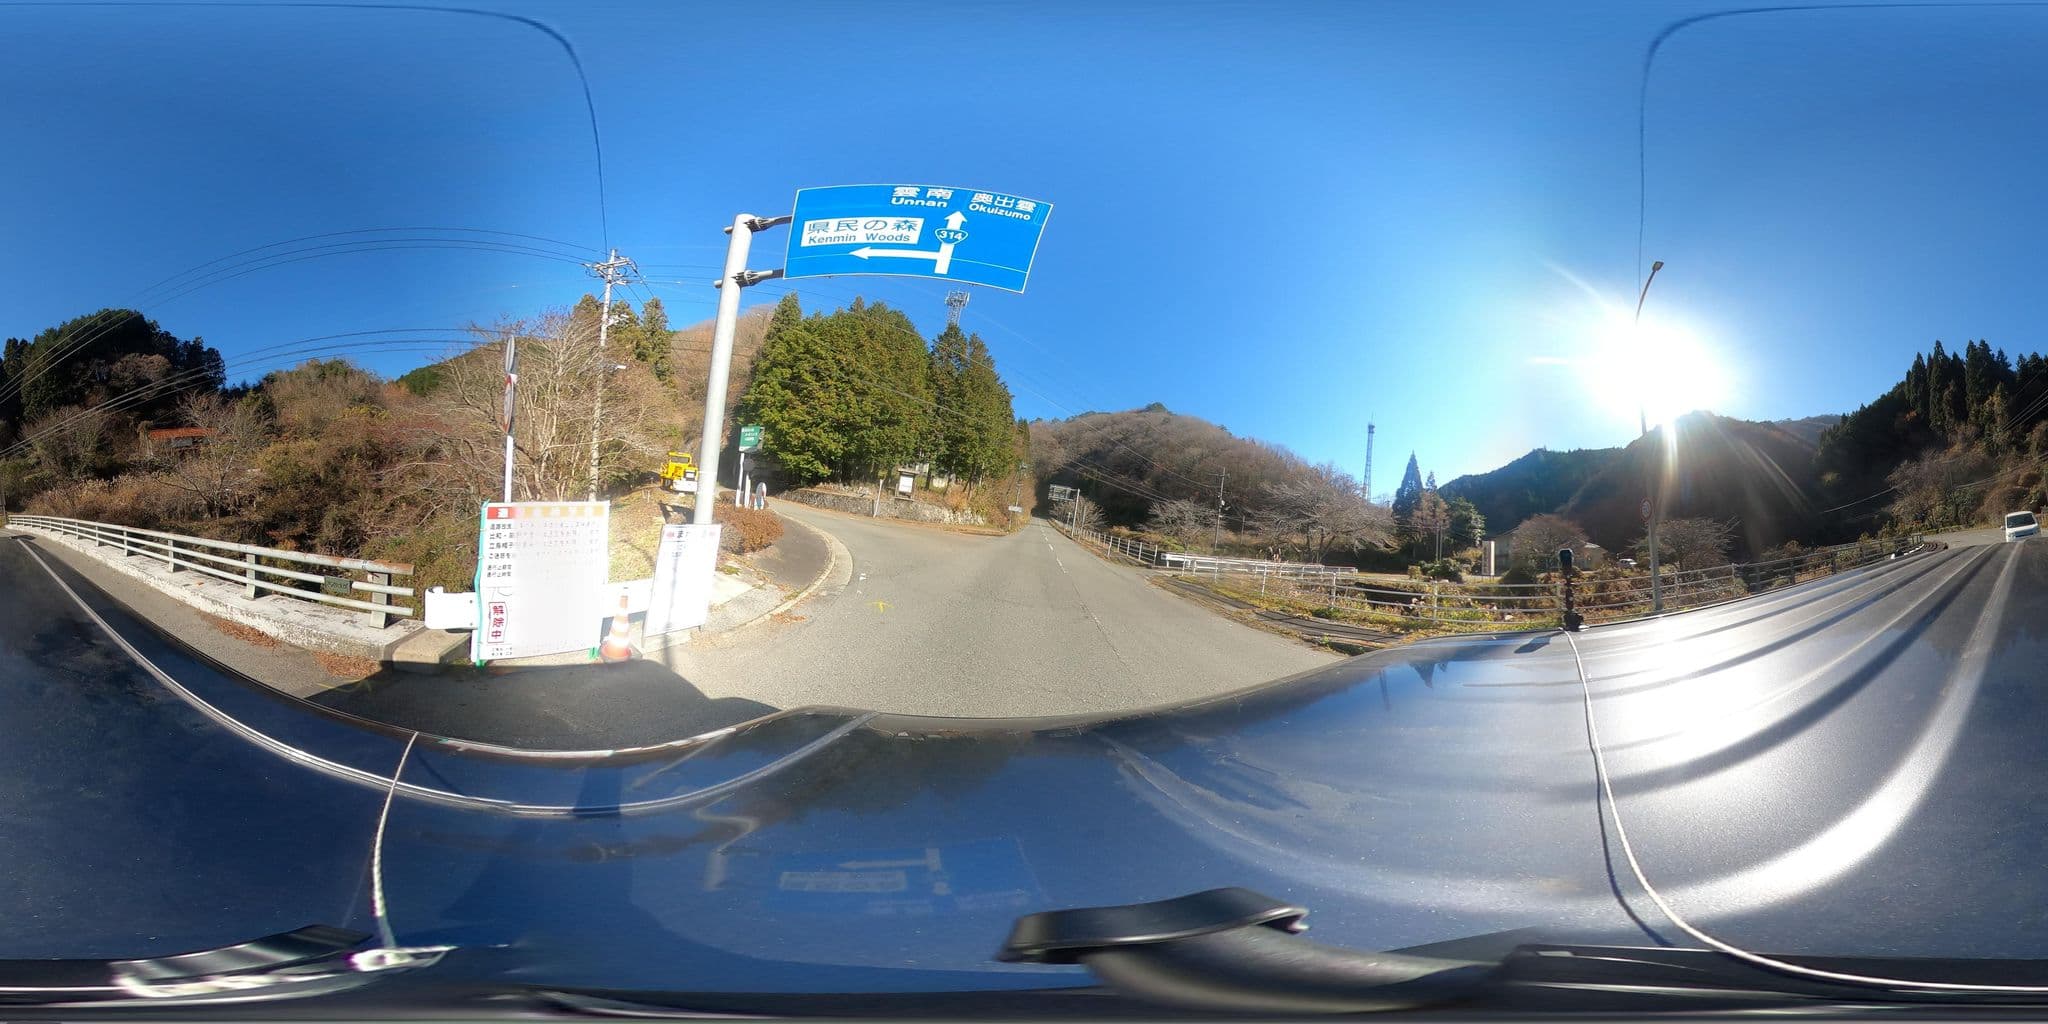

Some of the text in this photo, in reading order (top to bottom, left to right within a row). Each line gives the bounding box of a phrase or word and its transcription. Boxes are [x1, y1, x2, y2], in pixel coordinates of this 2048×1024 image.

[892, 187, 954, 199] 雲南
[891, 197, 948, 208] Unnan
[970, 192, 1036, 213] 奥出雲
[968, 203, 1031, 220] Okuizumo
[807, 219, 918, 235] 県民の森
[808, 232, 911, 244] Kenmin Woods
[940, 230, 963, 240] 314
